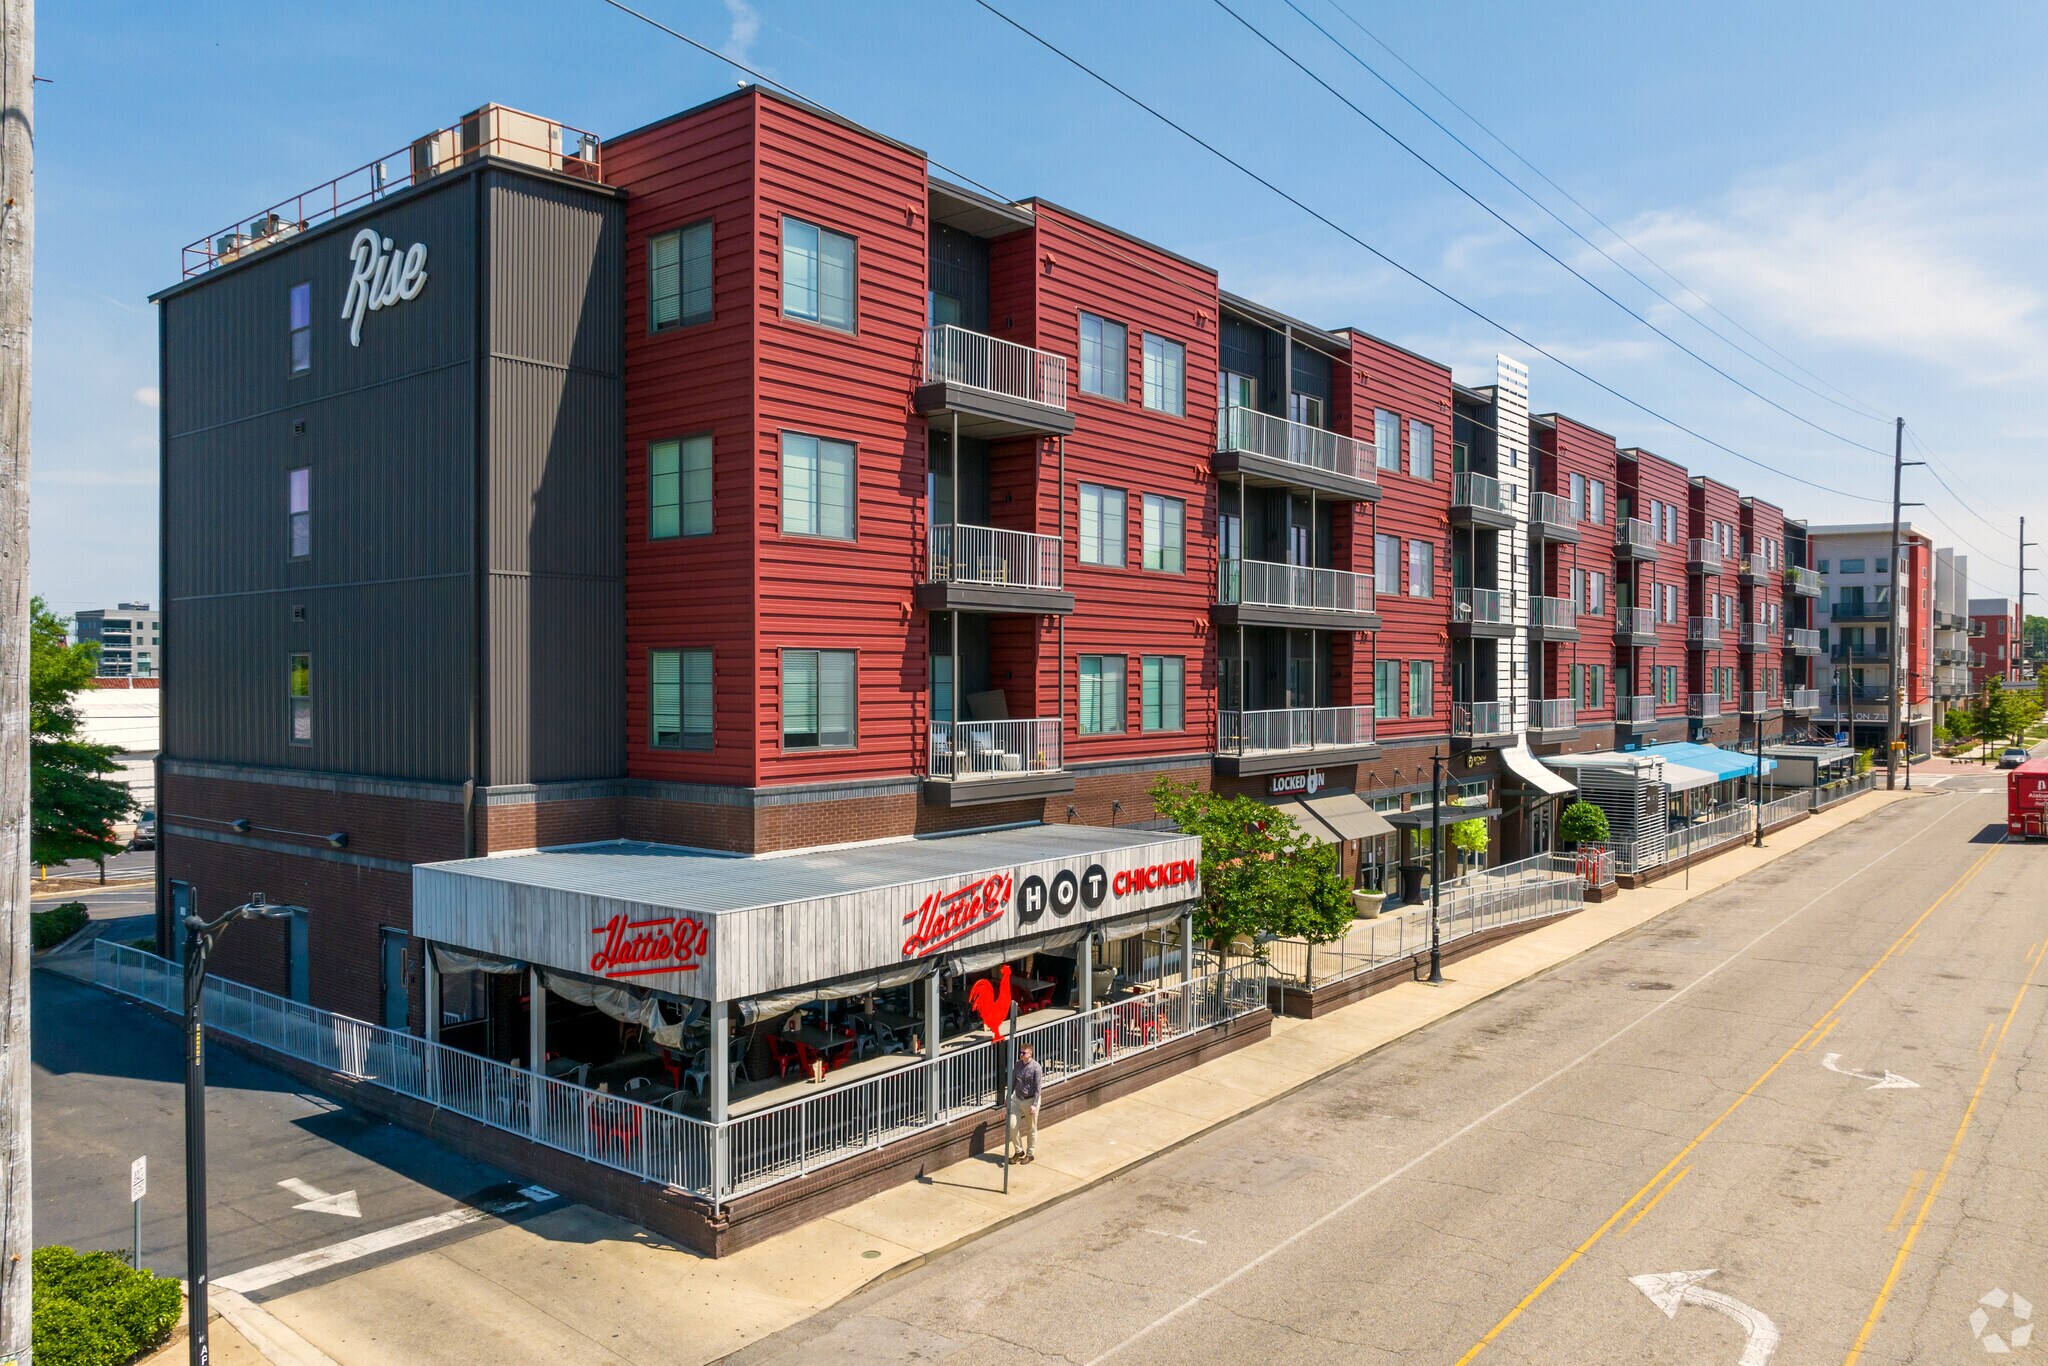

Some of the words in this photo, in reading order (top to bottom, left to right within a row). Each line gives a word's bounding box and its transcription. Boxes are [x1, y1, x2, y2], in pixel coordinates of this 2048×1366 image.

[341, 228, 428, 347] Rise
[1273, 775, 1306, 791] LOCKED
[590, 914, 672, 971] Hattie
[672, 917, 708, 961] B's
[903, 884, 984, 956] Hattie
[983, 871, 1013, 913] B's
[1026, 874, 1102, 912] HOT
[1113, 859, 1195, 896] CHICKEN
